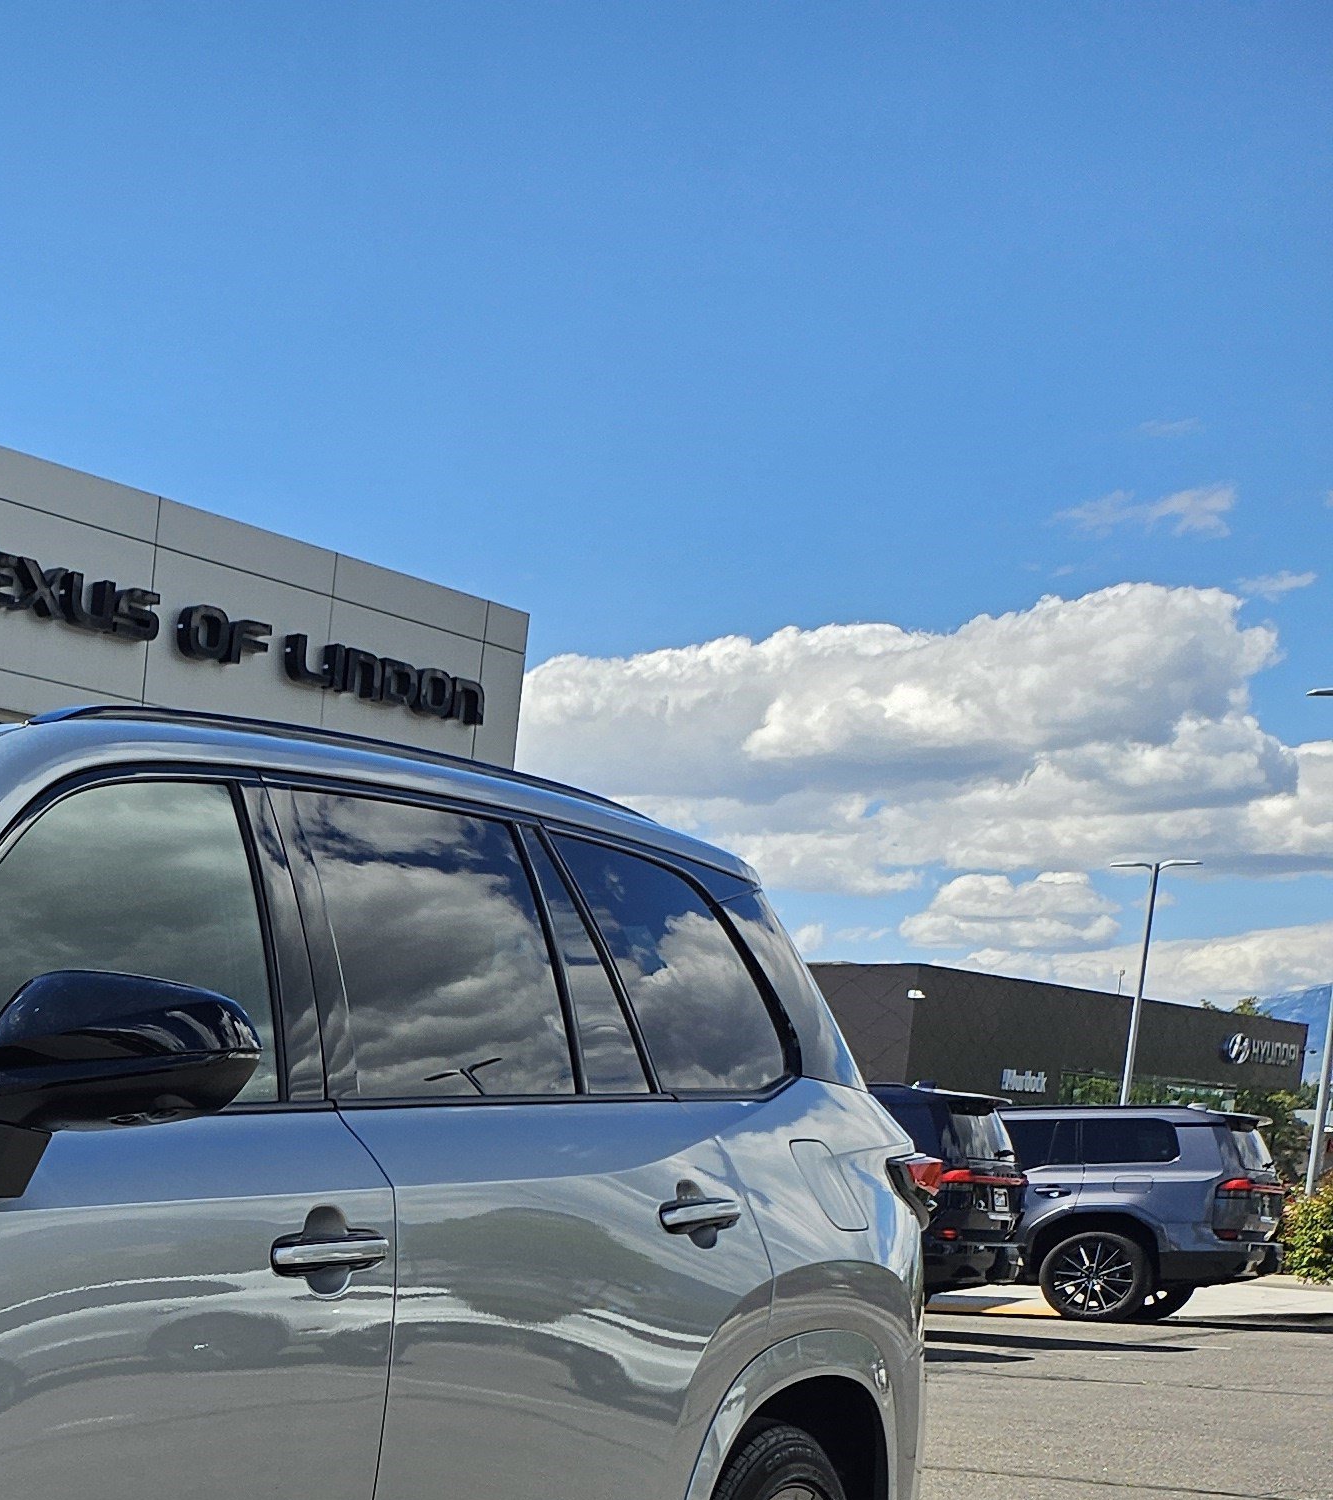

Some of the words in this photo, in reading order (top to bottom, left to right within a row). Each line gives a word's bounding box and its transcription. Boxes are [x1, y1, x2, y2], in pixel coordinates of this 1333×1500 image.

[176, 603, 273, 664] OF
[284, 633, 485, 726] LINDON
[1252, 1039, 1300, 1067] HYUNDAI
[1001, 1068, 1047, 1093] Murdock
